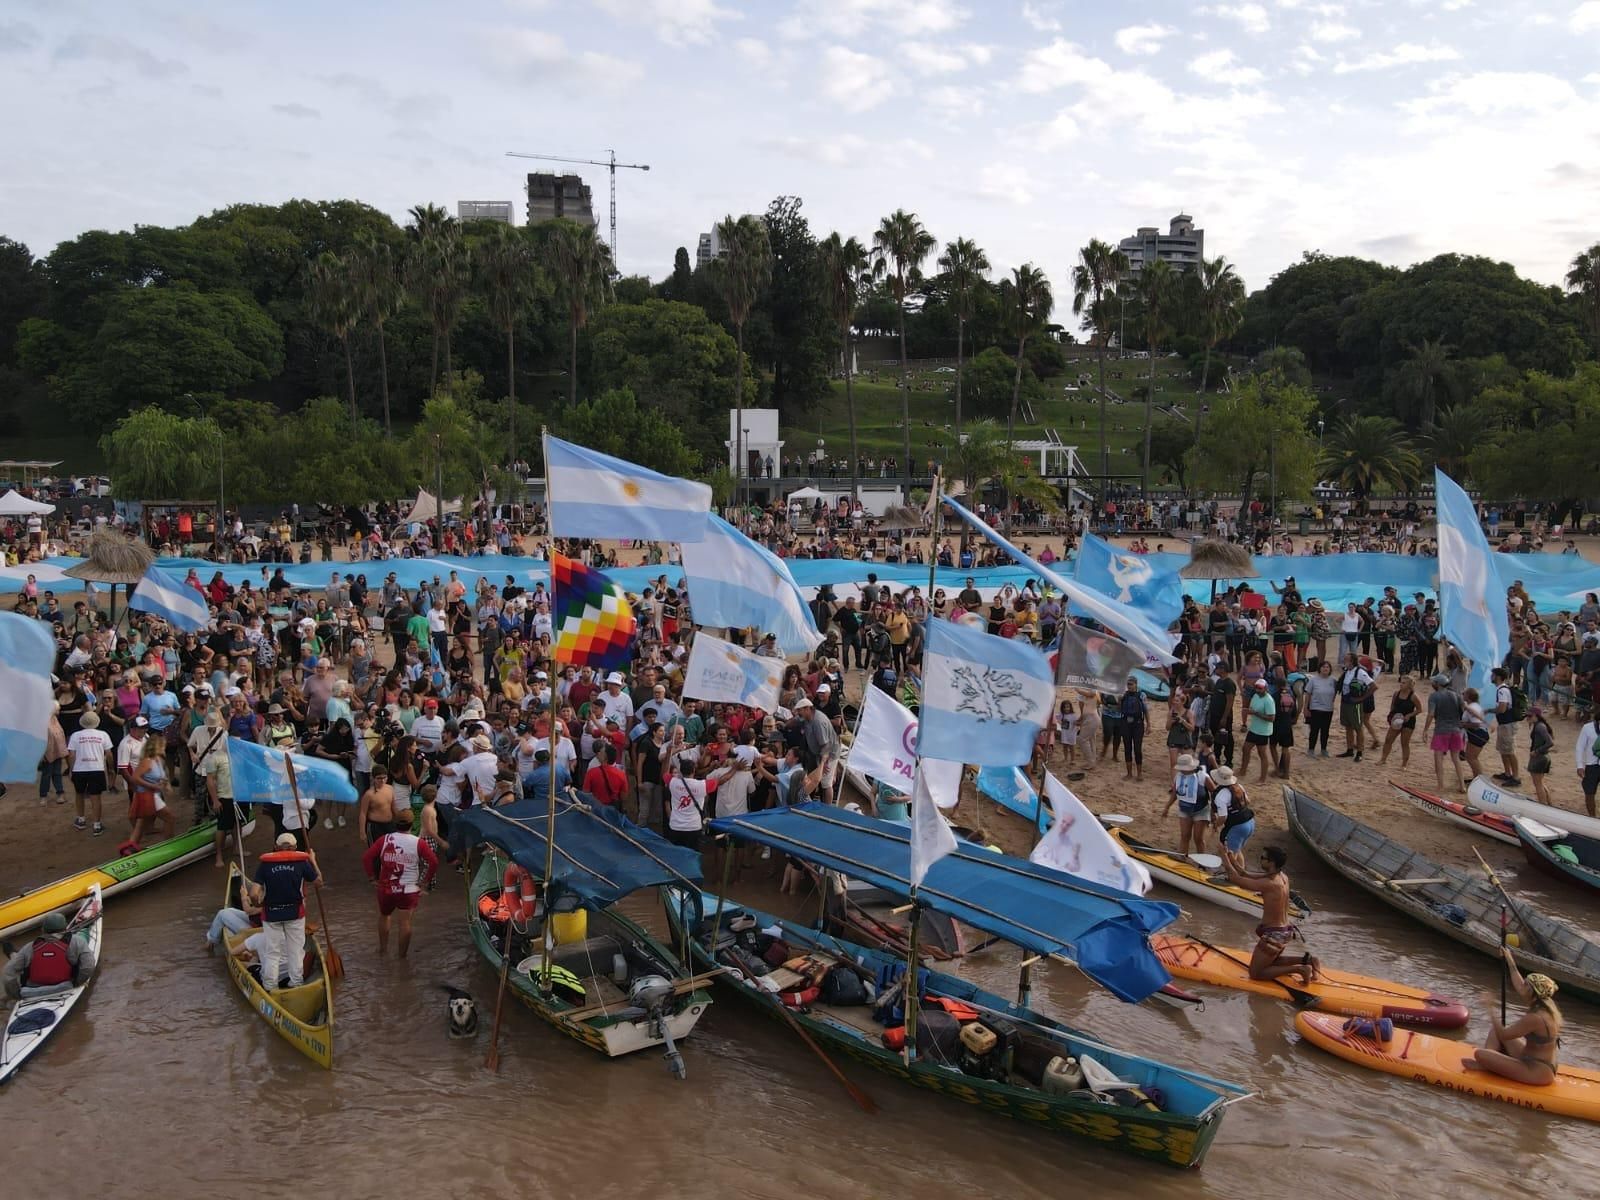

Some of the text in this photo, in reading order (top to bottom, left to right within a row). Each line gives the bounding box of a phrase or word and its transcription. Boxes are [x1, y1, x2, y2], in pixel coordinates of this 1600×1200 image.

[892, 758, 915, 780] PA
[1341, 1007, 1374, 1018] FUSION
[1432, 1079, 1546, 1111] AQUA MARINA
